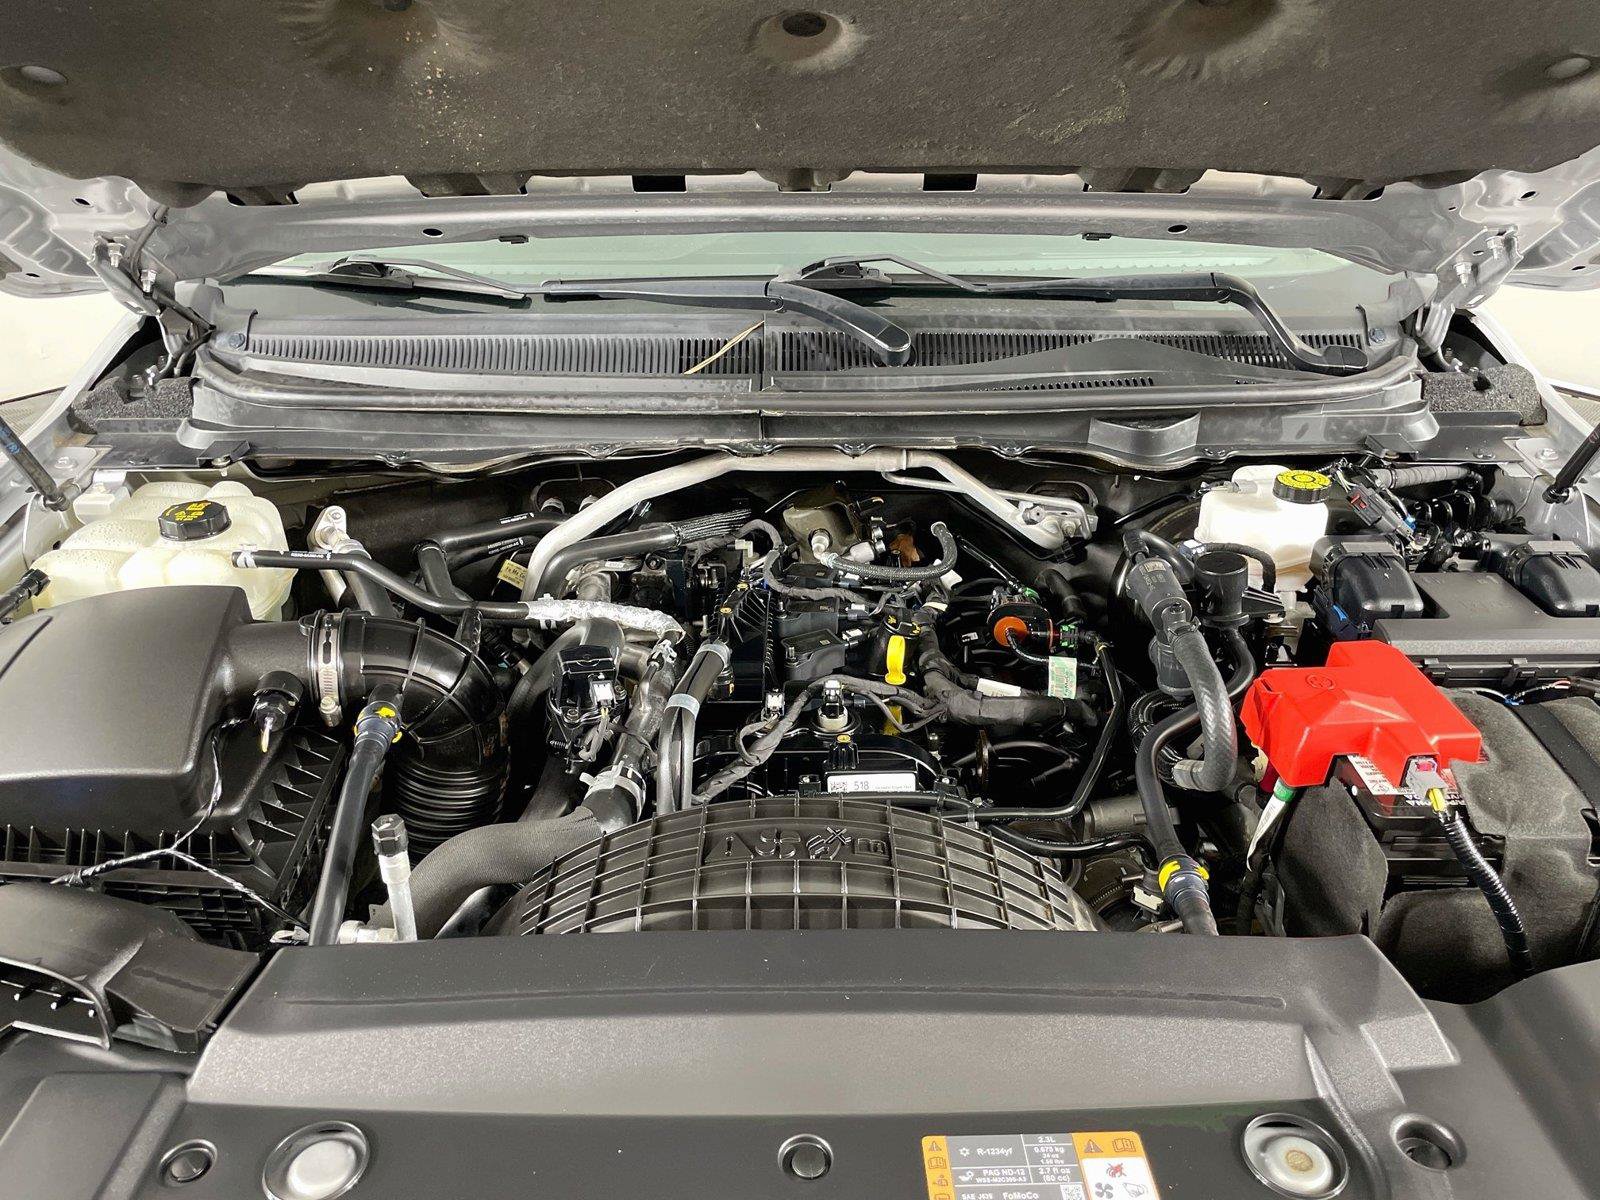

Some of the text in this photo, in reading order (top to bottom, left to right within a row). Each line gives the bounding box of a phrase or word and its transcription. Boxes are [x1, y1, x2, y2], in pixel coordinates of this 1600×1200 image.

[854, 781, 869, 790] 518
[976, 1147, 1013, 1157] R-1234yf
[1054, 1146, 1065, 1154] kg
[1001, 1168, 1026, 1176] ND-12
[1003, 1192, 1039, 1200] FoMoCo
